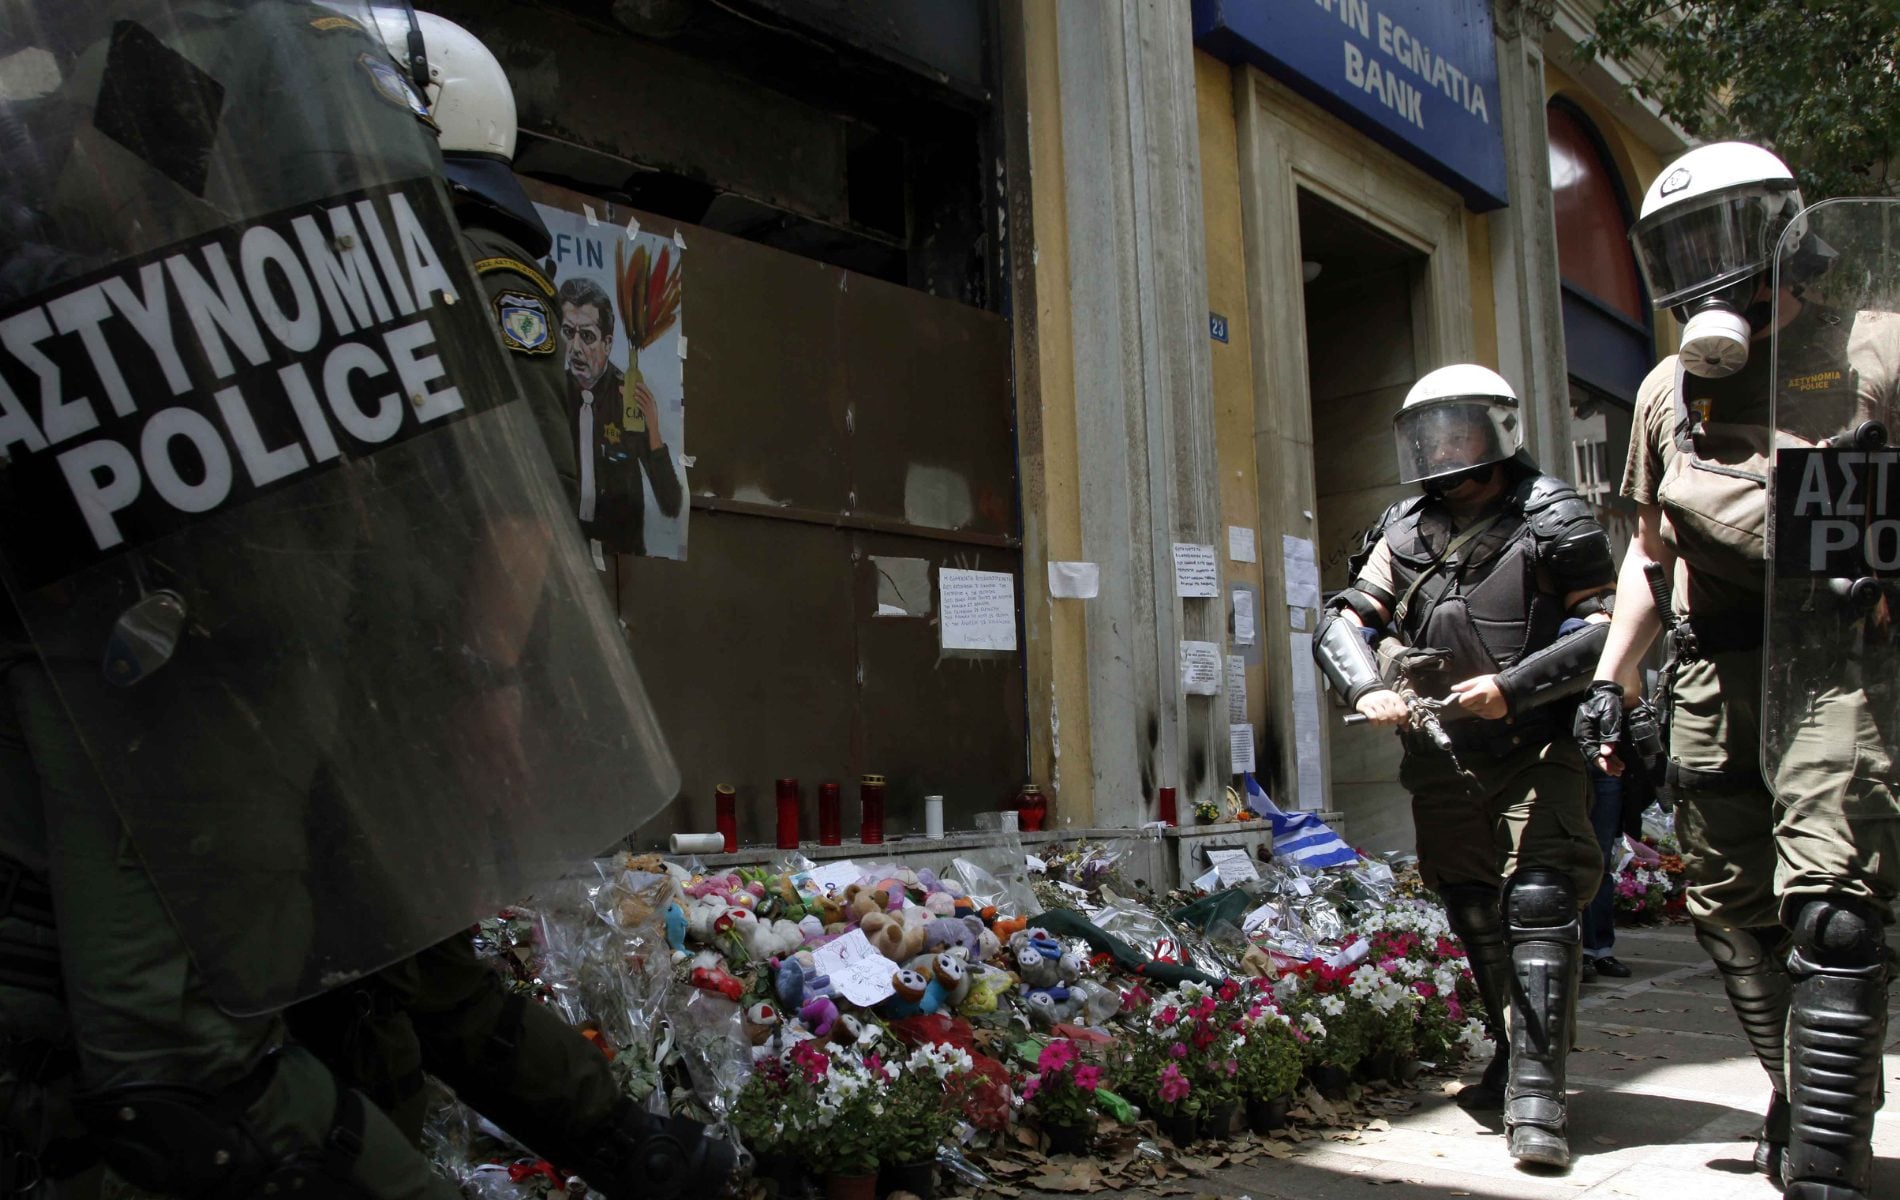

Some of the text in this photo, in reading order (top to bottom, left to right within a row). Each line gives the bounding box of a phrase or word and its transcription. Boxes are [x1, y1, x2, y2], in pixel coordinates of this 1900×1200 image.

[1314, 0, 1489, 124] IN EGNATIA
[1344, 40, 1424, 130] BANK
[57, 319, 465, 551] POLICE
[1800, 381, 1829, 391] POLICE
